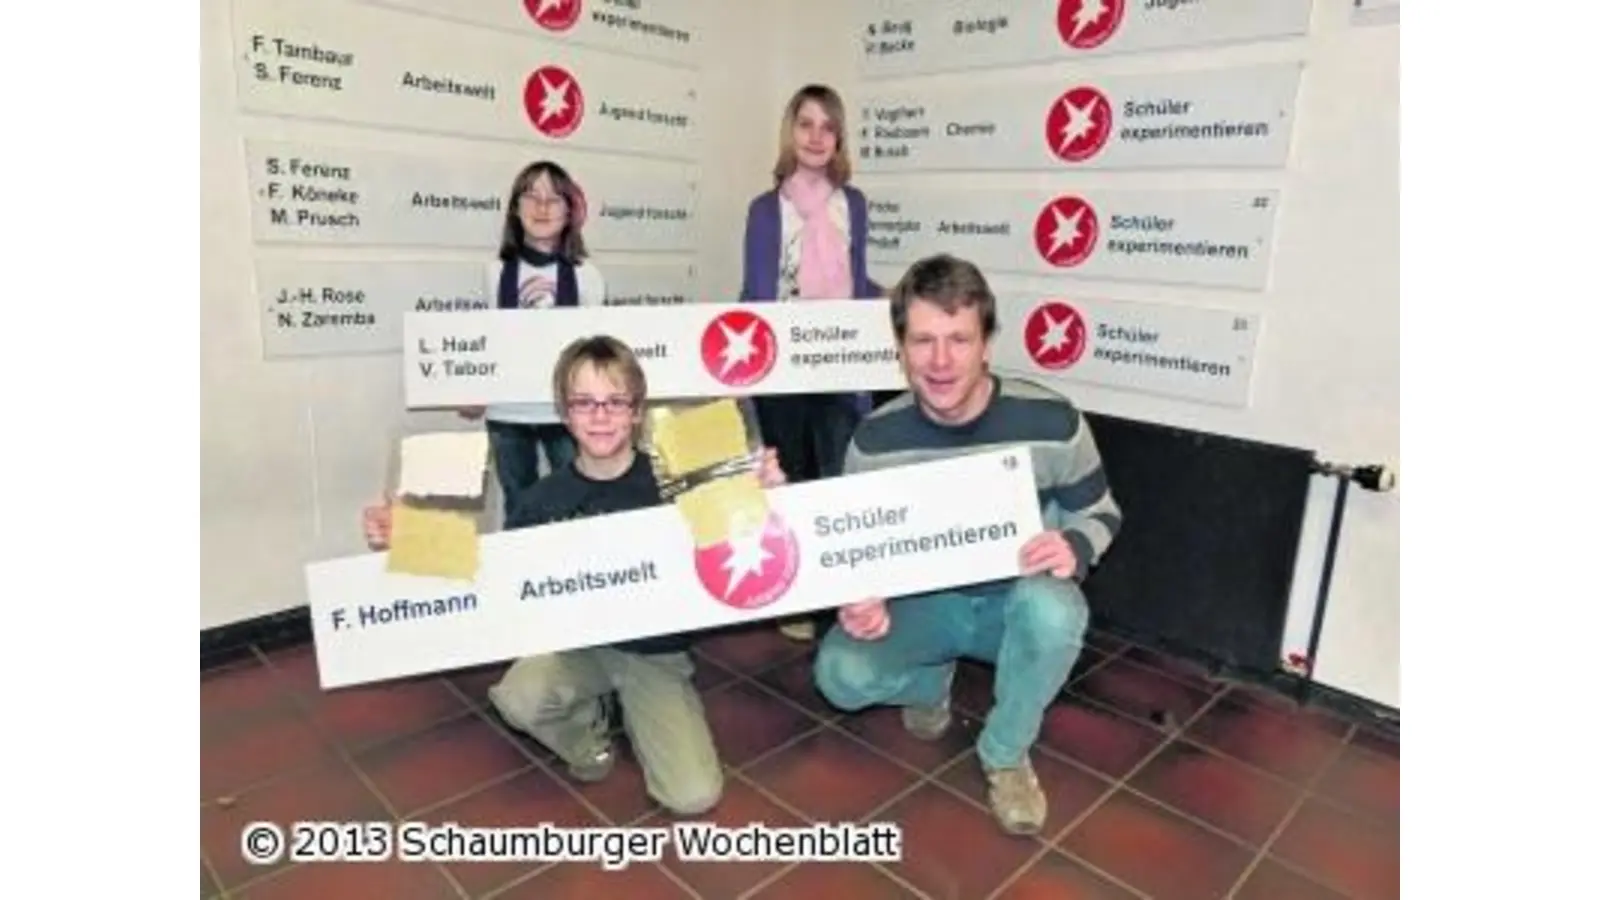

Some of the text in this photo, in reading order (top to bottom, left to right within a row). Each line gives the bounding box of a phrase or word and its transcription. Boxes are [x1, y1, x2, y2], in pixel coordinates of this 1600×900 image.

[403, 71, 495, 101] Arbeitswelt
[1124, 99, 1191, 117] Schüler
[1121, 121, 1269, 142] experimentieren
[265, 157, 286, 175] S.
[412, 191, 501, 211] Arbeitswelt
[1110, 215, 1175, 232] Schüler
[1107, 238, 1248, 258] experimentieren
[322, 286, 366, 304] Rose
[301, 311, 376, 328] Zaremba
[790, 325, 858, 343] Schüler
[1098, 323, 1159, 343] Schüler
[441, 335, 487, 353] Haaf
[443, 360, 497, 376] Tabor
[1094, 347, 1230, 376] experimentieren
[813, 505, 909, 537] Schüler
[820, 520, 1018, 570] experimentieren
[520, 560, 658, 600] Arbeitswelt
[331, 592, 478, 631] F. Hoffmann
